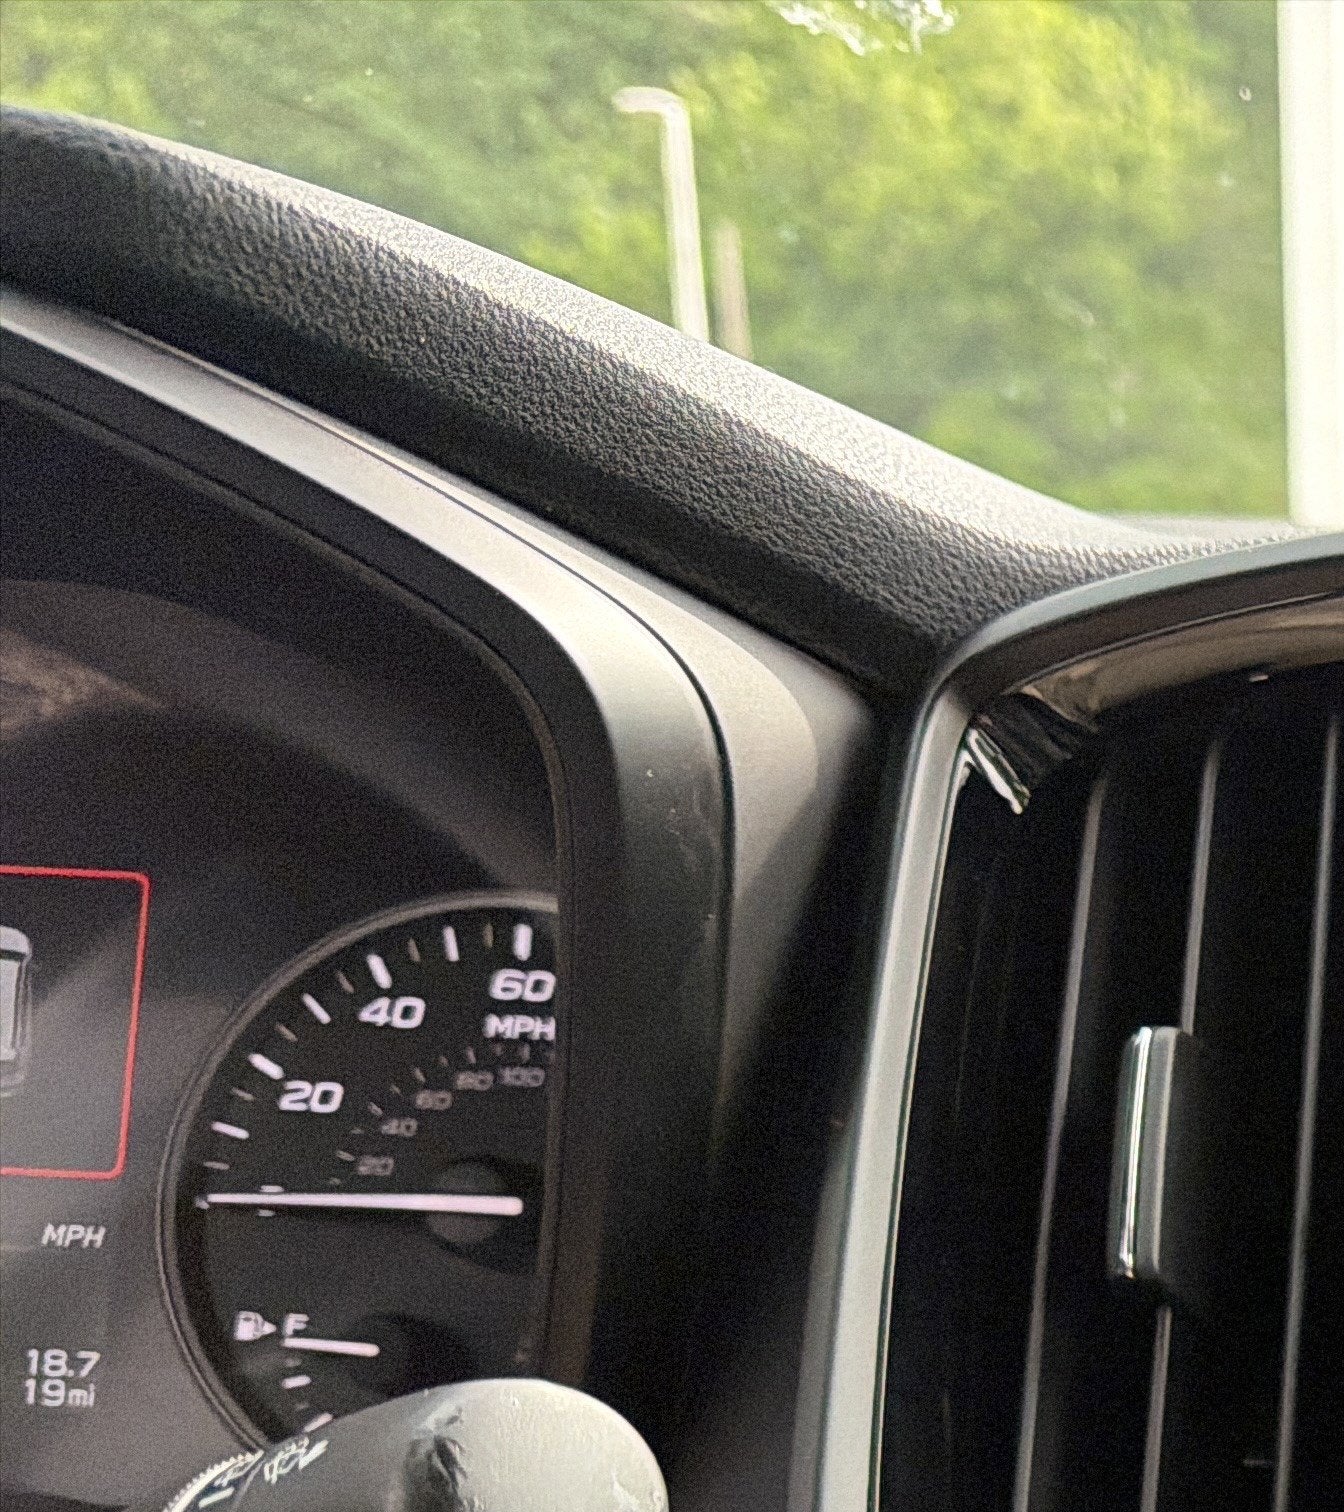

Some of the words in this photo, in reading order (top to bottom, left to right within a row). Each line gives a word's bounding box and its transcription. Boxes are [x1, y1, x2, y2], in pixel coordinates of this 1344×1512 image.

[487, 967, 557, 1003] 60
[356, 995, 427, 1030] 40
[483, 1013, 556, 1040] MPH
[277, 1079, 345, 1114] 20
[40, 1222, 106, 1249] MPH
[281, 1312, 311, 1338] F
[27, 1348, 101, 1379] 18.7
